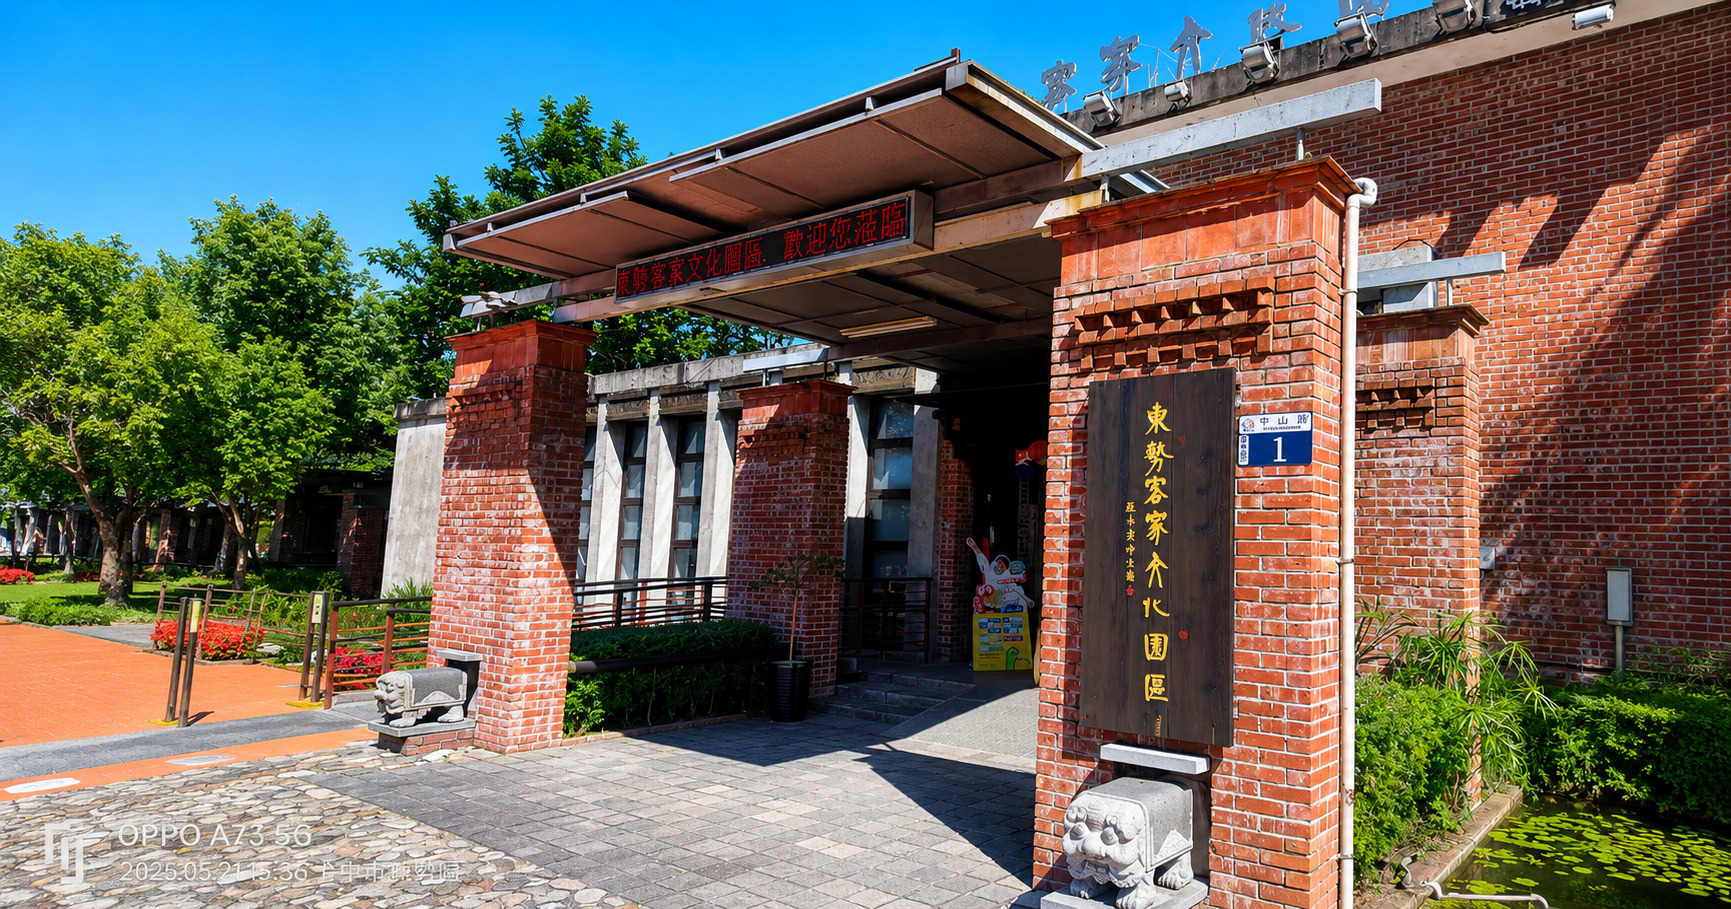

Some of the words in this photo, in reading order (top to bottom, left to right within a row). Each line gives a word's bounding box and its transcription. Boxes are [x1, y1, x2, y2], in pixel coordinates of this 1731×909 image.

[784, 202, 906, 260] 歡迎您蒞臨
[1273, 436, 1287, 462] 1
[1143, 402, 1174, 702] 東勢客家文化園區
